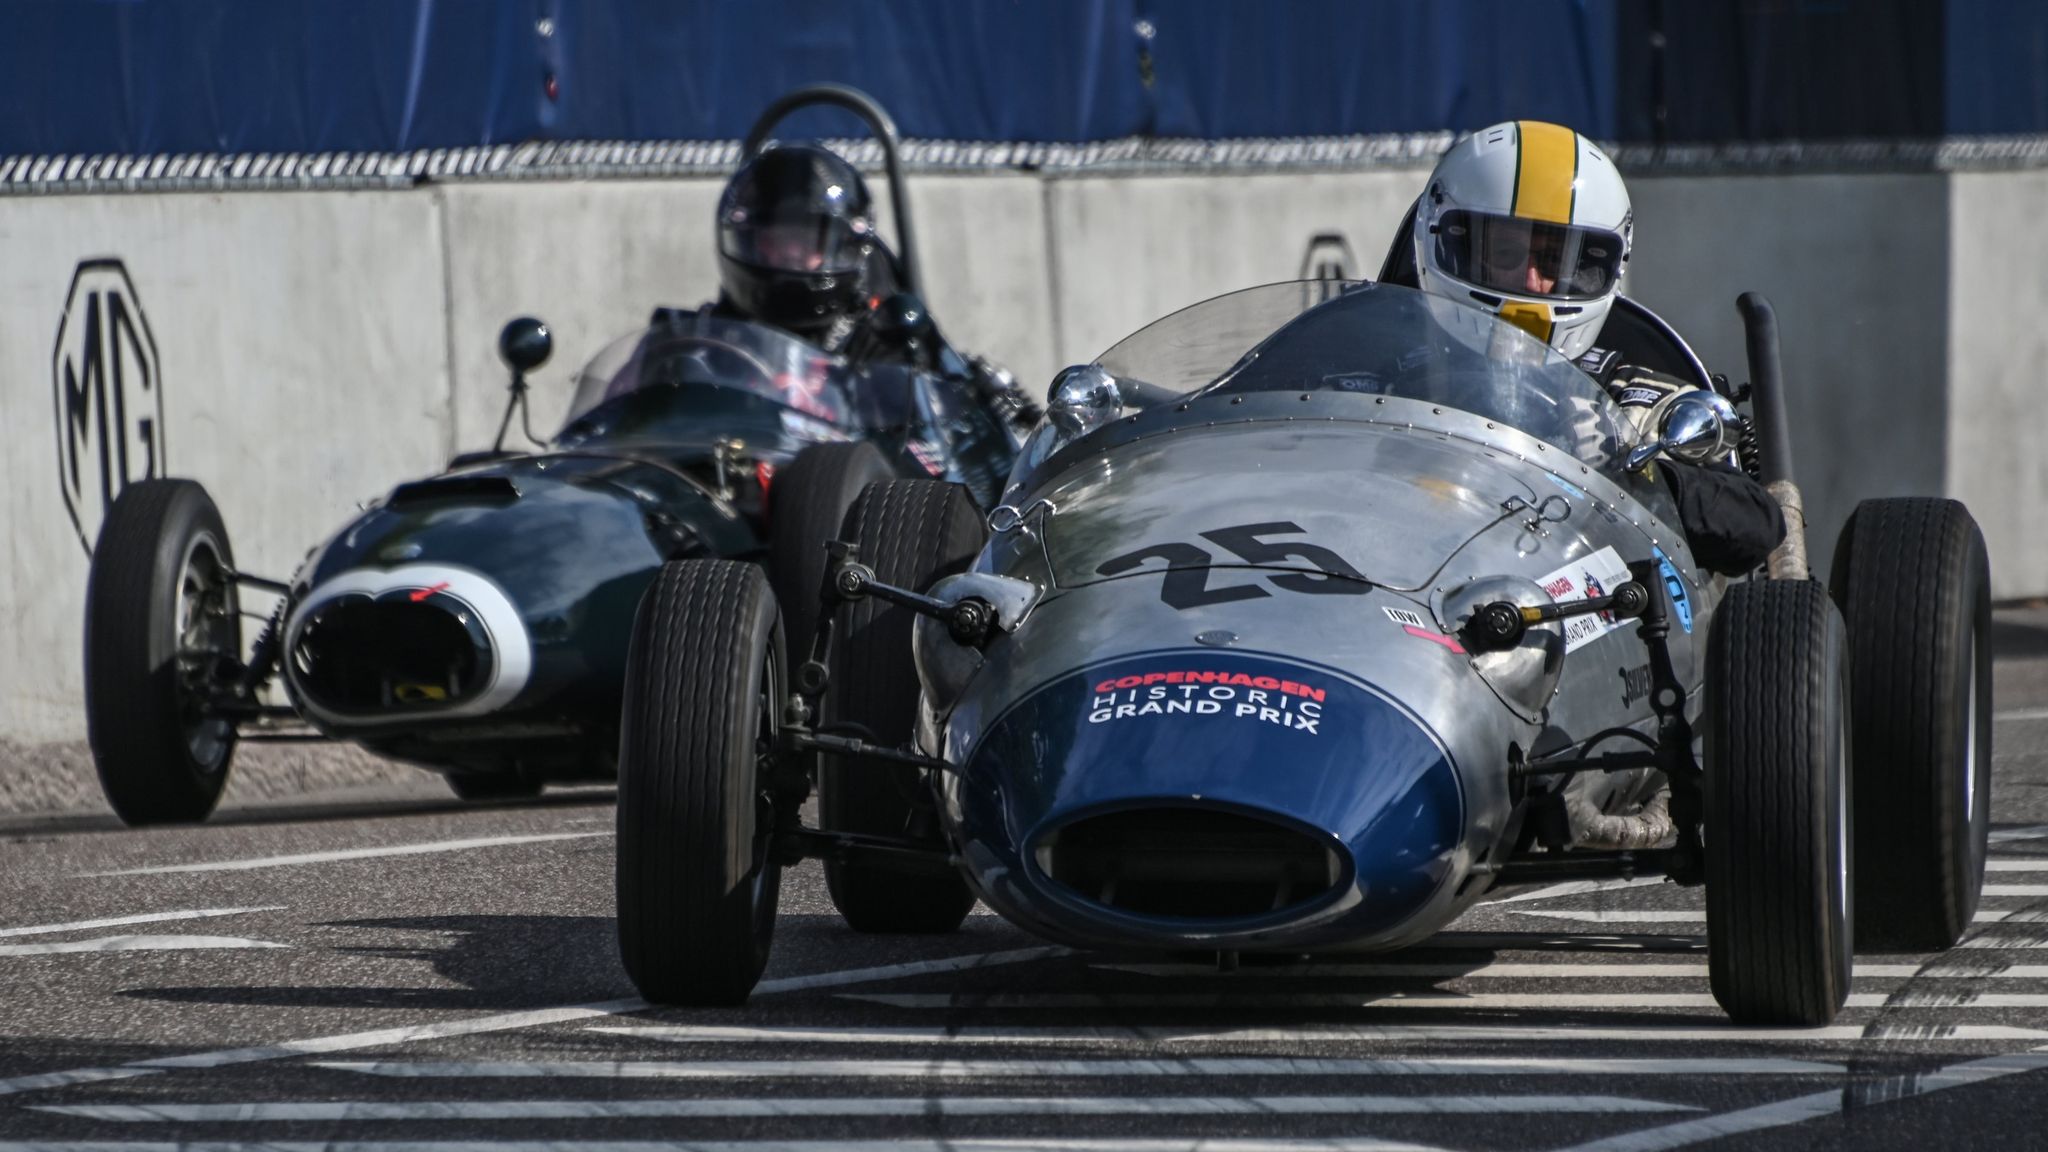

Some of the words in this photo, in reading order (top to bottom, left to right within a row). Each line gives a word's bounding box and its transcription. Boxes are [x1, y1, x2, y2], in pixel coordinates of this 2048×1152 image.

[65, 291, 154, 515] MG
[1621, 390, 1659, 401] OMP
[1096, 521, 1373, 610] 25
[1386, 609, 1420, 625] TOW
[1580, 616, 1598, 637] PRIX
[1093, 685, 1322, 718] HISTORIC
[1095, 671, 1326, 702] COPENHAGEN
[1088, 700, 1222, 724] GRAND
[1235, 703, 1319, 735] PRIX
